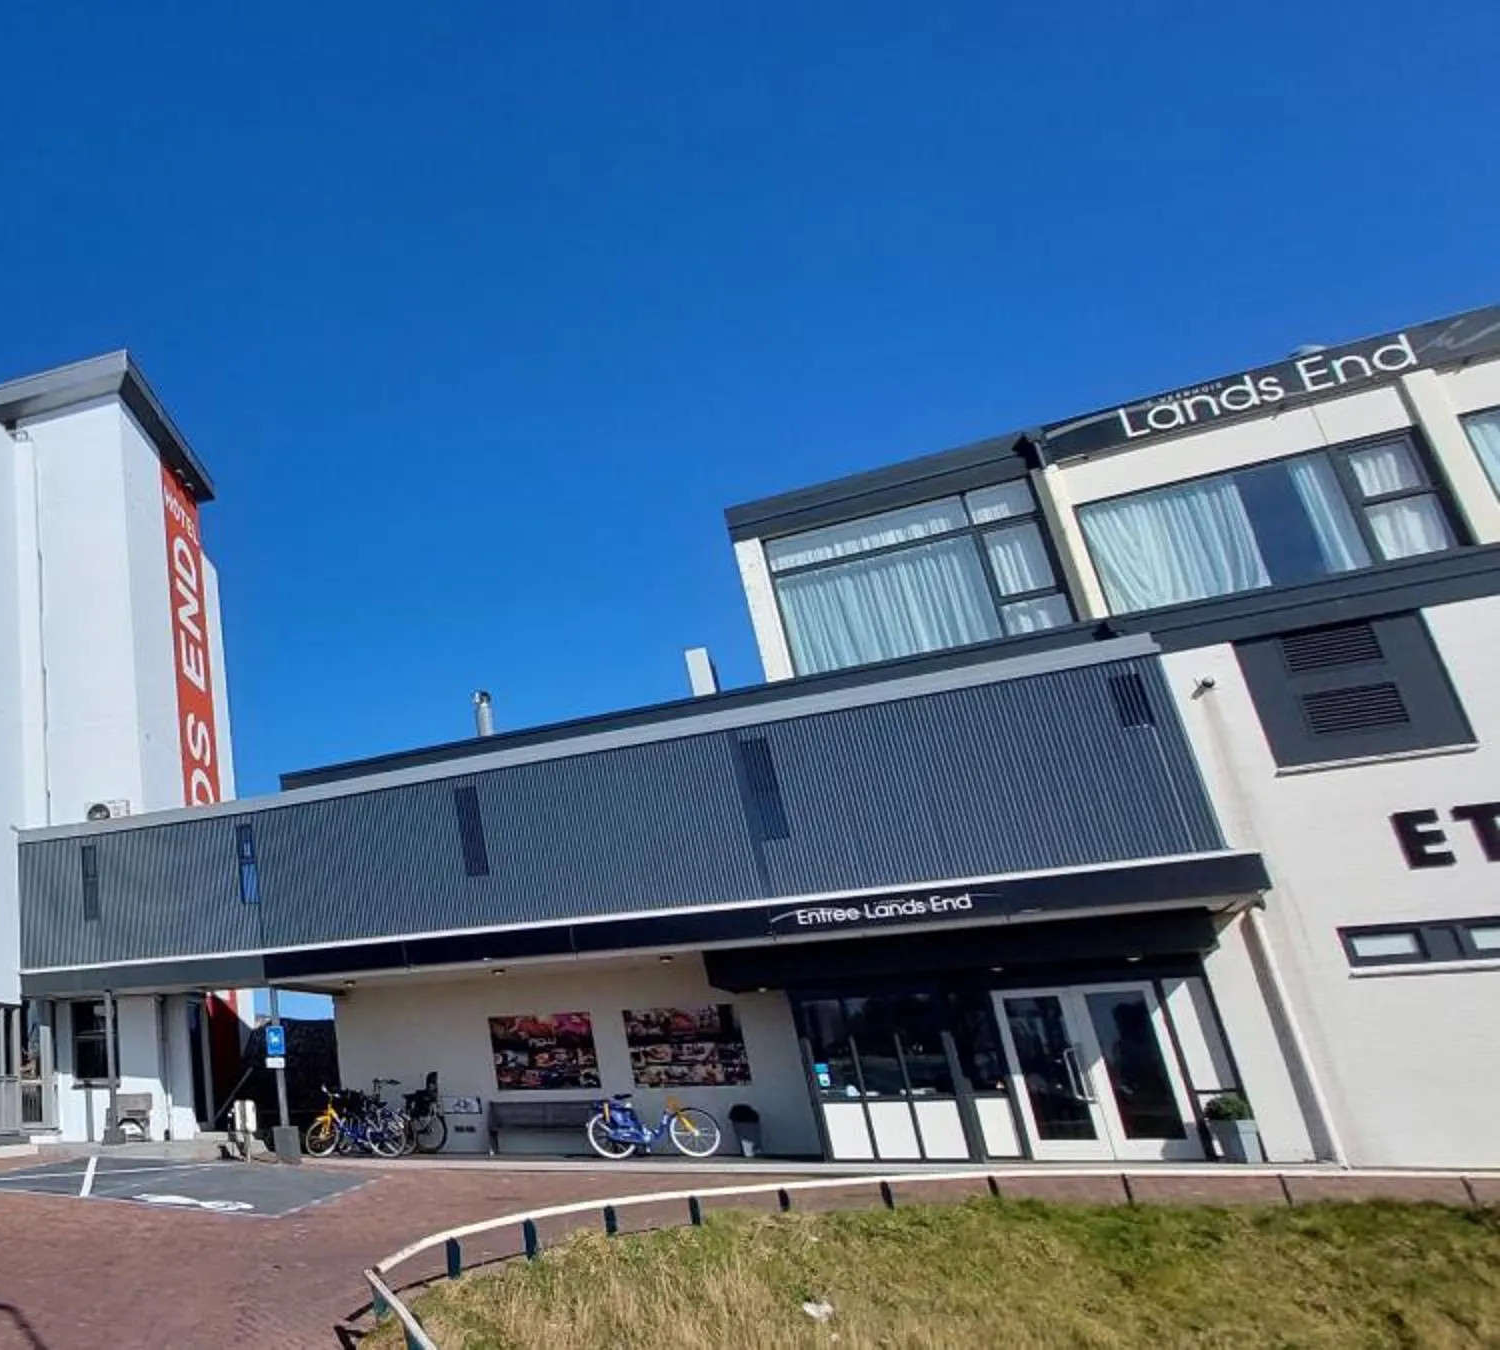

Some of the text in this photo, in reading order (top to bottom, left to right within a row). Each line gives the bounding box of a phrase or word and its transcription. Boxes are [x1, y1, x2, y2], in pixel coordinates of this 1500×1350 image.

[1117, 333, 1418, 438] Lands End
[164, 486, 200, 547] HOTEL
[172, 535, 206, 693] END
[796, 907, 861, 925] Entree
[863, 898, 926, 919] Lands
[929, 892, 973, 913] End
